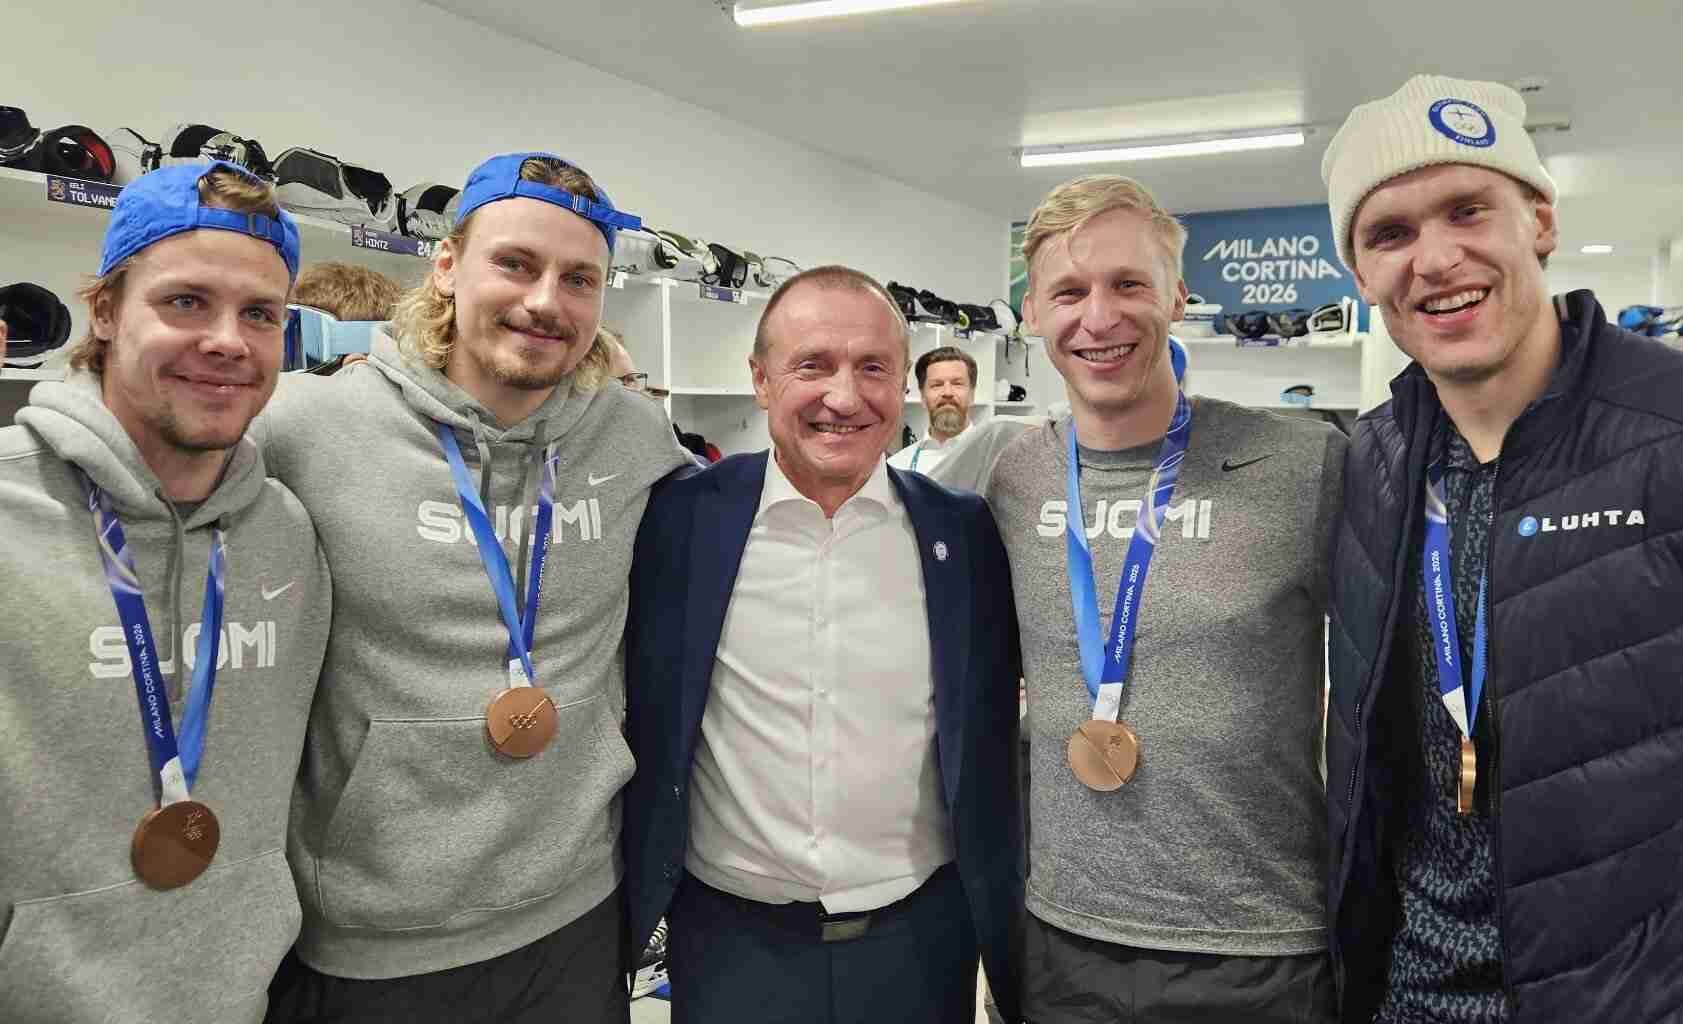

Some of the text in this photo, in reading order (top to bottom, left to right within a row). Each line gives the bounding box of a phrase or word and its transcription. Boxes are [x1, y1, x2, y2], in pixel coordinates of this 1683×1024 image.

[1203, 235, 1319, 260] MILANO
[1222, 258, 1342, 281] CORTINA
[1242, 283, 1297, 304] 2026
[1541, 510, 1645, 532] LUHTA
[1431, 550, 1452, 667] MILANO CORTINA 2026
[1114, 624, 1128, 664] MILANO
[1121, 585, 1136, 624] CORTINA
[132, 622, 164, 738] MILANO CORTINA 2026
